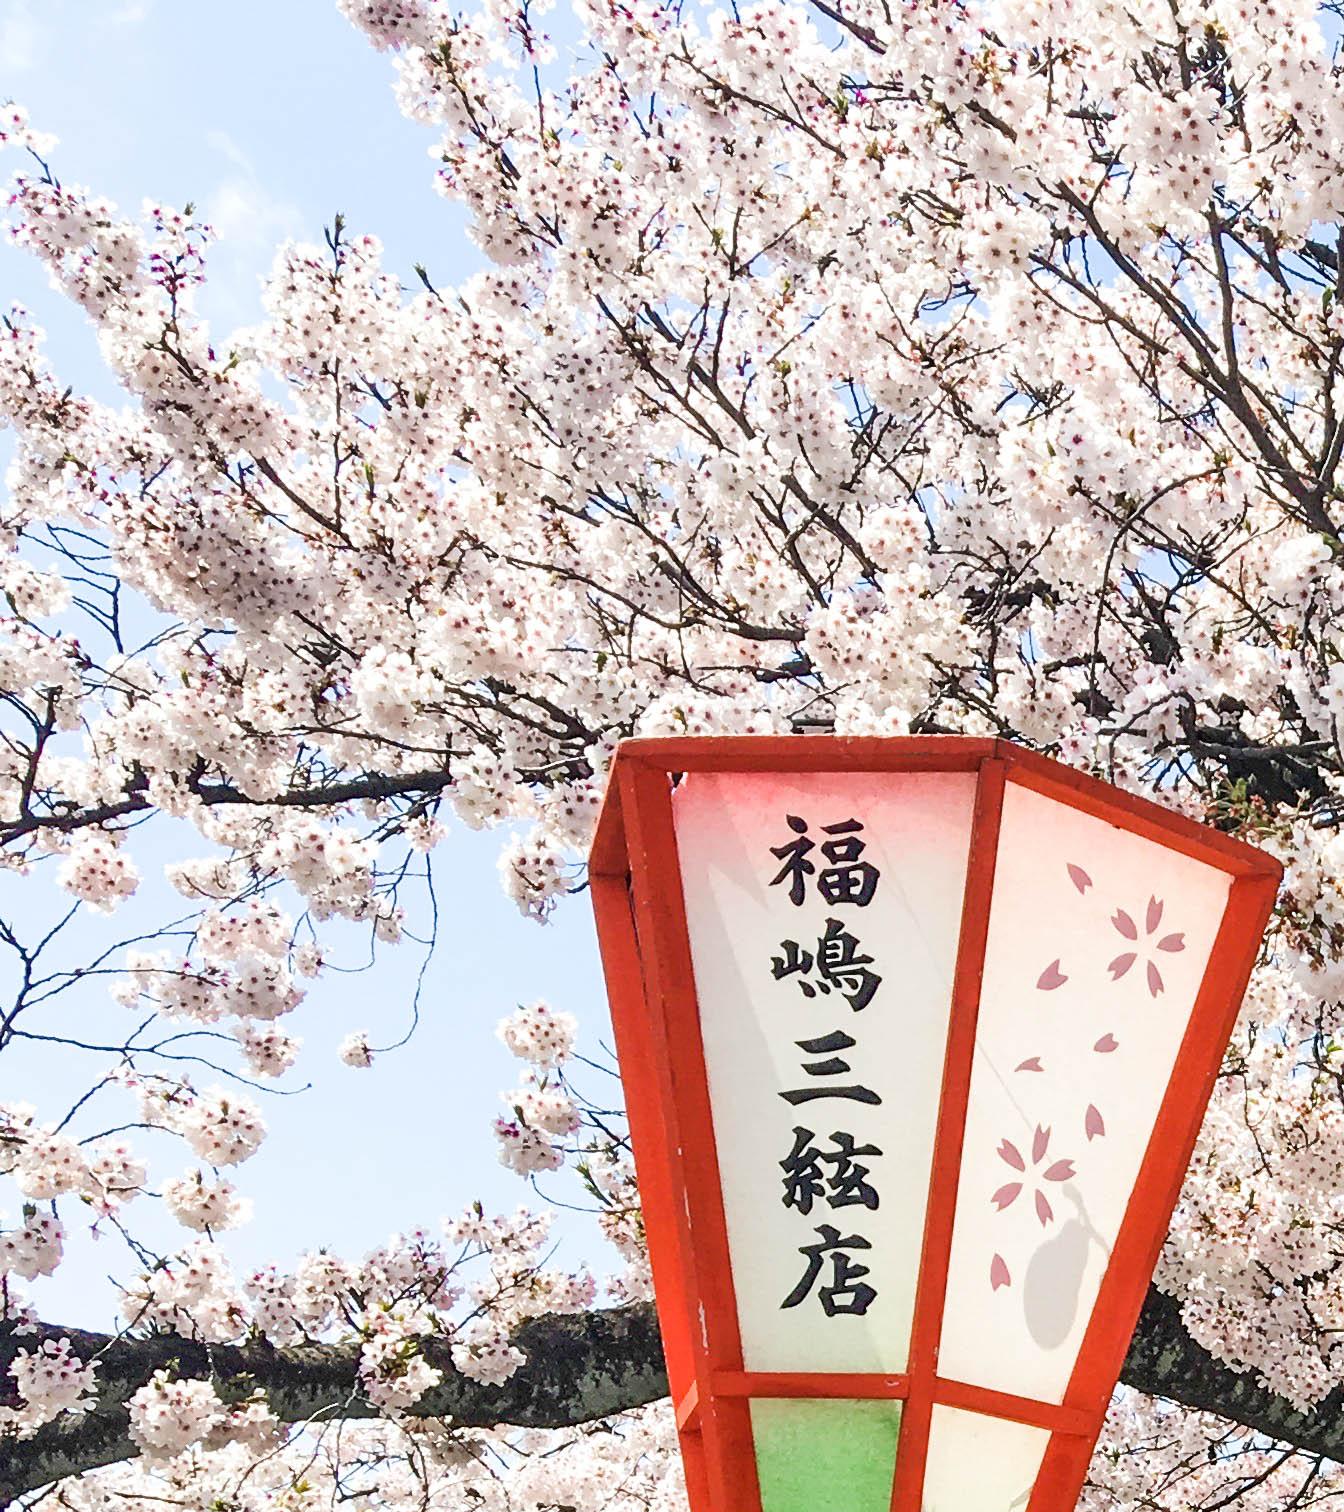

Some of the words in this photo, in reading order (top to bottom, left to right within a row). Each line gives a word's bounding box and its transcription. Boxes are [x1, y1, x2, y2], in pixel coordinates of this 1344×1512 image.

[768, 815, 883, 1318] 福嶋三絃店
